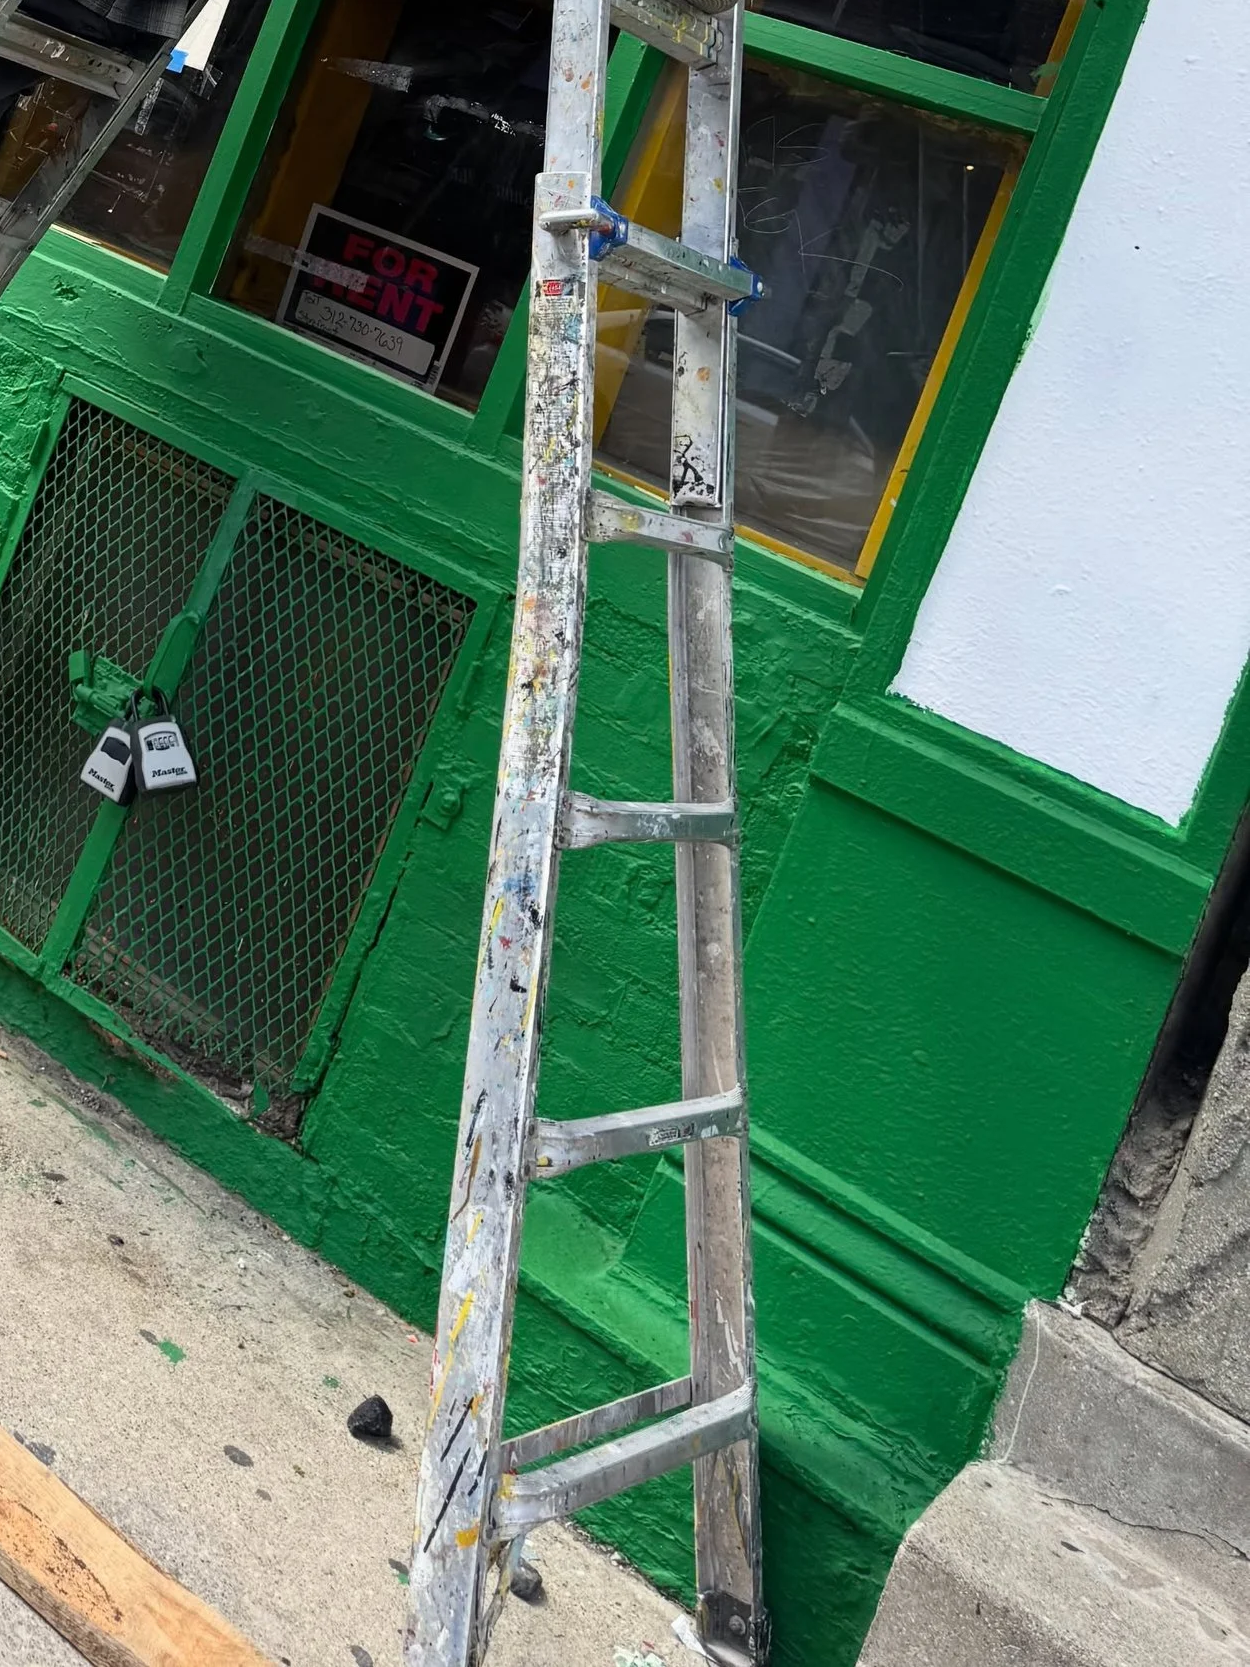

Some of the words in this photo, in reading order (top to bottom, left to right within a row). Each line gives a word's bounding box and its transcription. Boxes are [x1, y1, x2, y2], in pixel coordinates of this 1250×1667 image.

[341, 233, 440, 294] FOR
[318, 305, 404, 356] 312-730-7639
[87, 768, 115, 789] Master
[151, 766, 186, 778] Master
